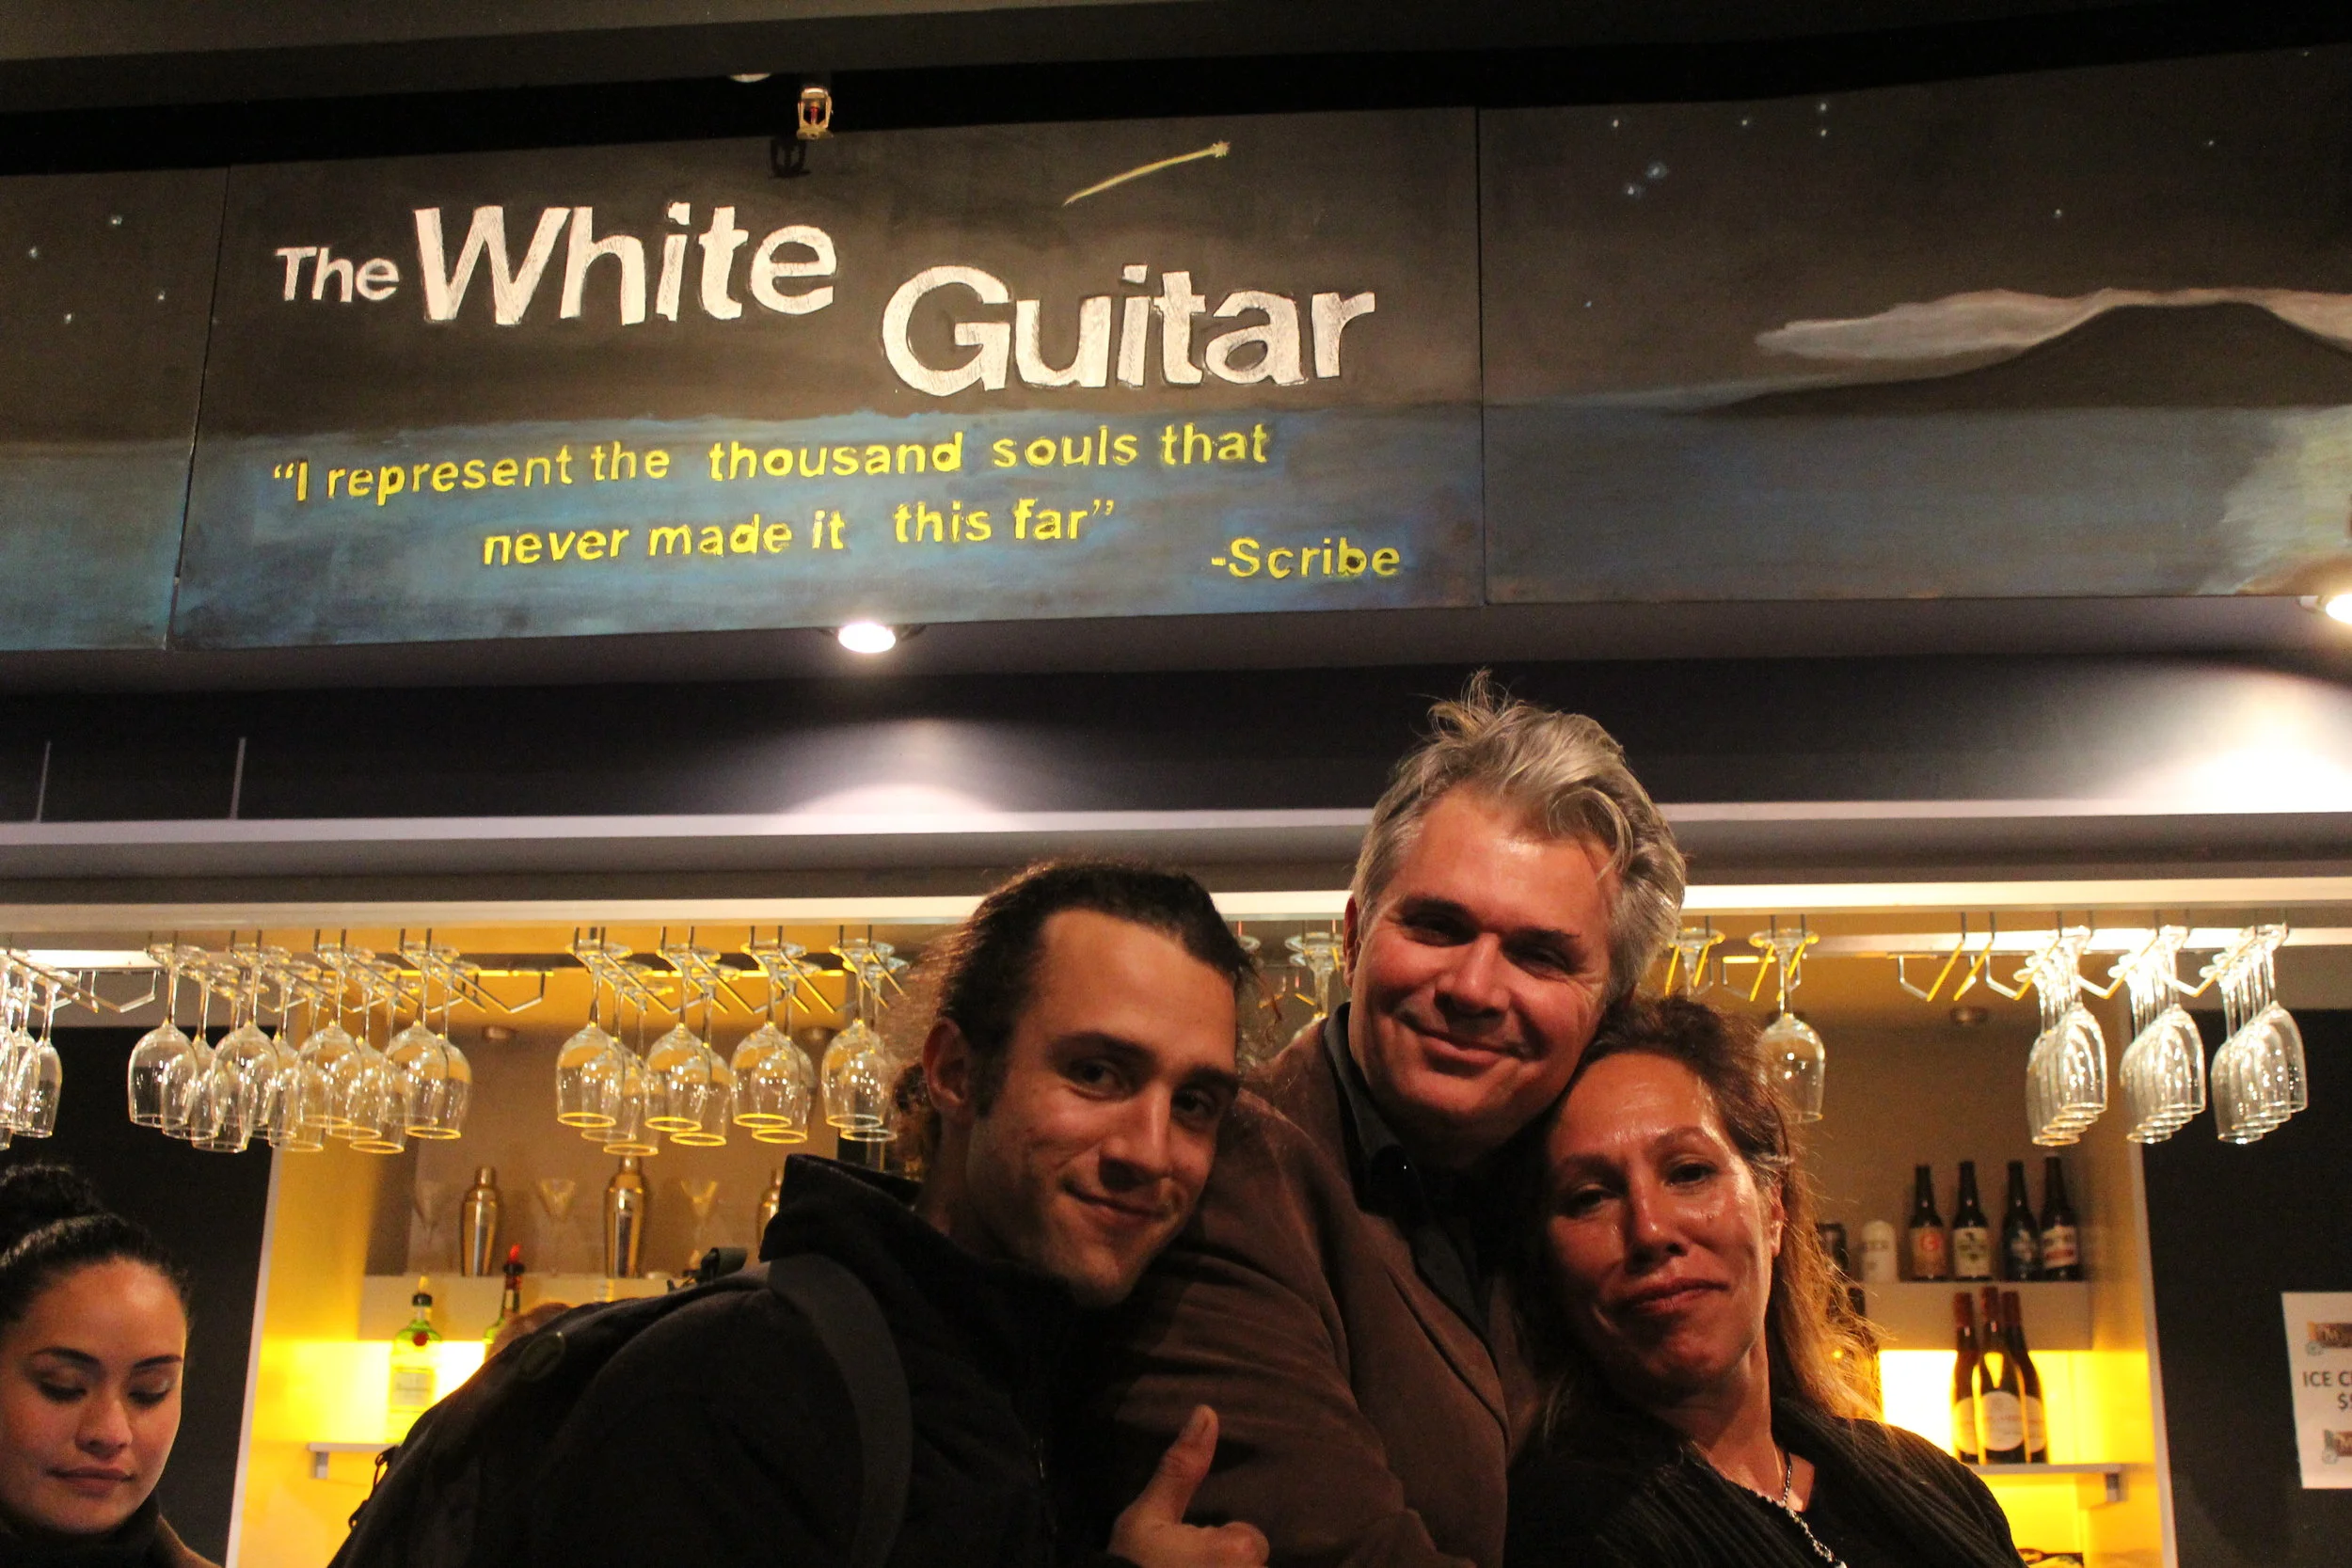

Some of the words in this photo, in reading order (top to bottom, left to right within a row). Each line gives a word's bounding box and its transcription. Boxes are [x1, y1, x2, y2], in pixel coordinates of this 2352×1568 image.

[275, 245, 400, 303] The
[414, 201, 836, 325] White
[882, 264, 1375, 396] Guitar
[326, 444, 573, 506] represent
[591, 440, 670, 481] the
[708, 432, 963, 481] thousand
[993, 425, 1137, 467] souls
[1160, 422, 1269, 465] that
[483, 529, 629, 565] never
[648, 513, 793, 556] made
[811, 509, 845, 550] it
[894, 503, 992, 543] this
[1211, 536, 1401, 578] -Scribe
[2303, 1370, 2331, 1386] ICE
